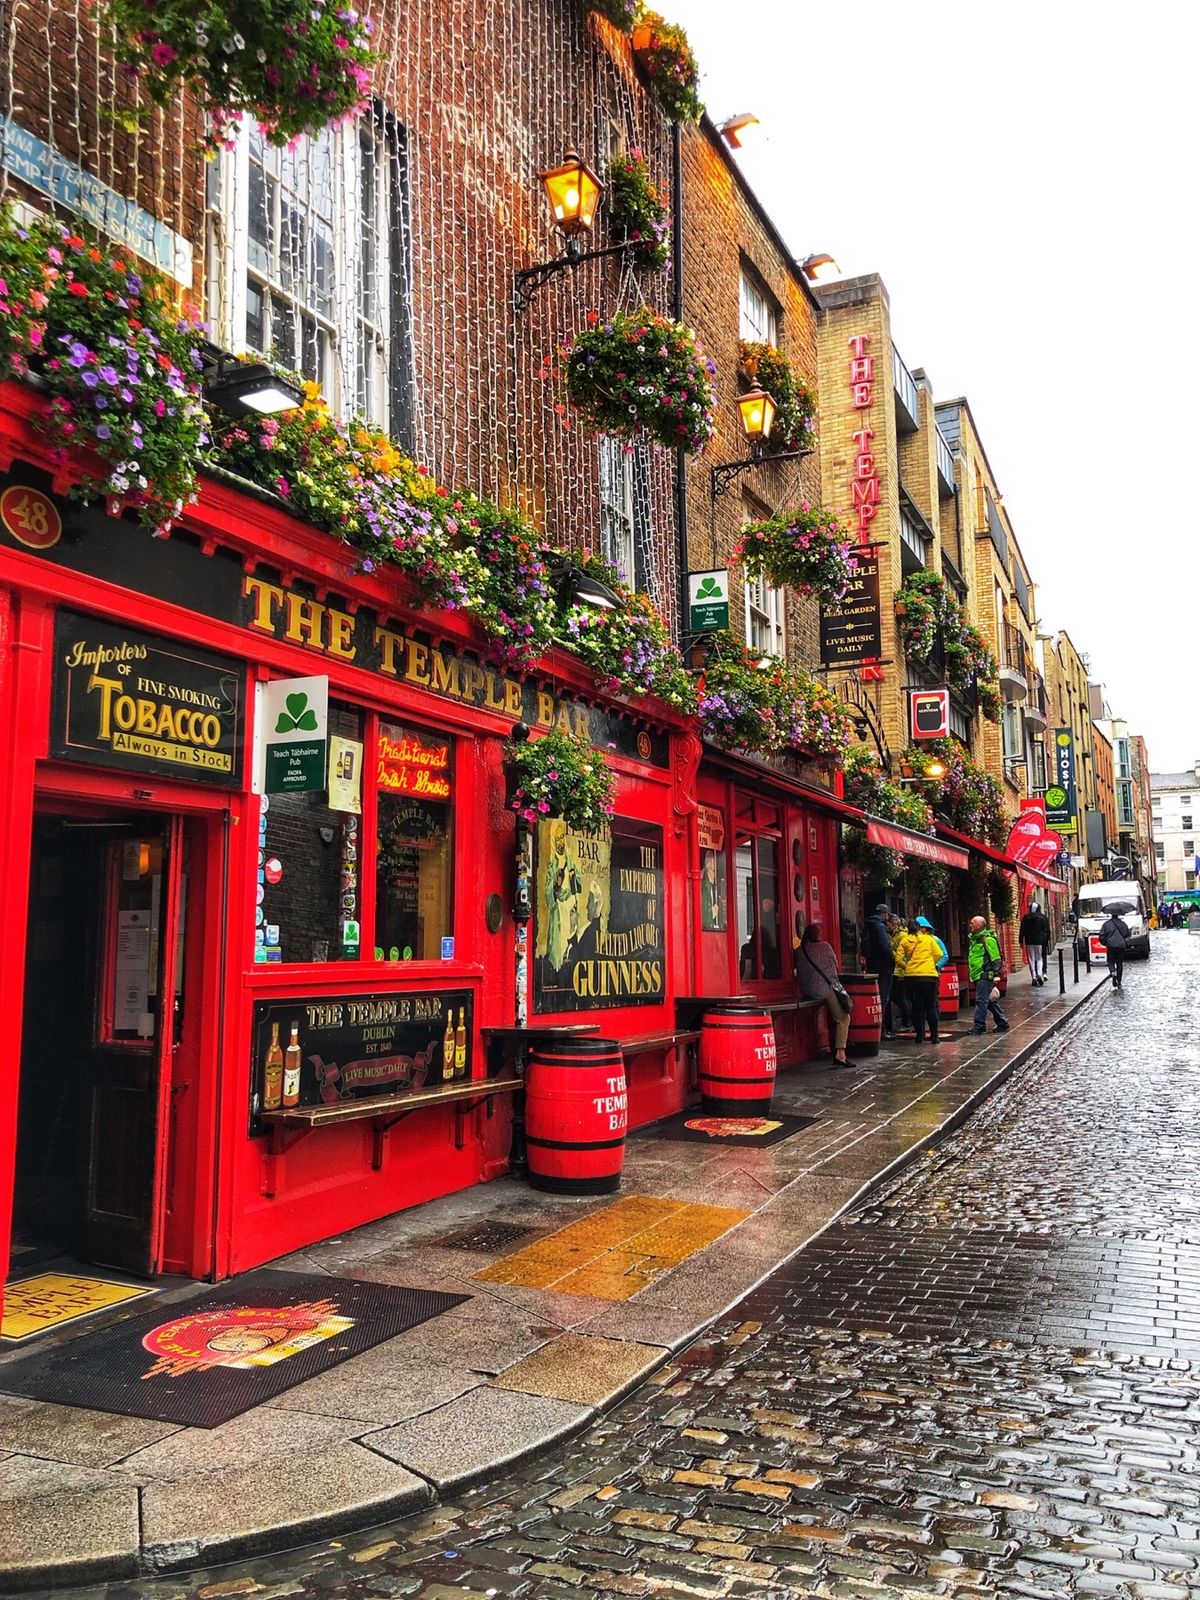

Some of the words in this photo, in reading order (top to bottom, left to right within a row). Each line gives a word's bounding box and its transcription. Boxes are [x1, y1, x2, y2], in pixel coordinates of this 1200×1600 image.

[848, 334, 874, 409] THE
[851, 428, 881, 559] TEMPL
[11, 494, 49, 535] 48
[844, 605, 876, 616] GARDEN
[826, 636, 845, 646] LIVE
[846, 634, 875, 644] MUSIC
[837, 644, 864, 653] DAILY
[65, 641, 148, 675] Importers
[117, 663, 132, 676] OF
[244, 576, 357, 662] THE
[374, 627, 523, 718] TEMPLE
[537, 690, 592, 739] BAR
[137, 676, 167, 700] FINE
[168, 685, 222, 711] SMOKING
[87, 674, 222, 748] TOBACCO
[115, 733, 168, 757] Always
[174, 746, 188, 761] in
[192, 750, 230, 770] Stock
[273, 750, 290, 758] Teach
[289, 758, 302, 766] Pub
[378, 736, 447, 767] Traditional
[283, 775, 307, 783] APPROVED
[577, 840, 600, 863] BAR
[640, 846, 656, 869] THE
[620, 868, 656, 895] EMPEROR
[647, 899, 656, 921] OF
[594, 929, 628, 957] MALTED
[629, 922, 660, 954] LIQUORS
[573, 960, 662, 997] GUINNESS
[306, 1003, 344, 1030] THE
[347, 998, 411, 1026] TEMPLE
[414, 997, 442, 1020] BAR
[362, 1025, 396, 1042] DUBLIN
[365, 1044, 379, 1054] EST.
[344, 1068, 363, 1083] LIVE
[363, 1065, 387, 1079] MUSIC
[386, 1062, 409, 1076] DAILY
[4, 1285, 44, 1301] HE
[4, 1282, 103, 1318] EMPLE
[27, 1295, 106, 1319] BAR
